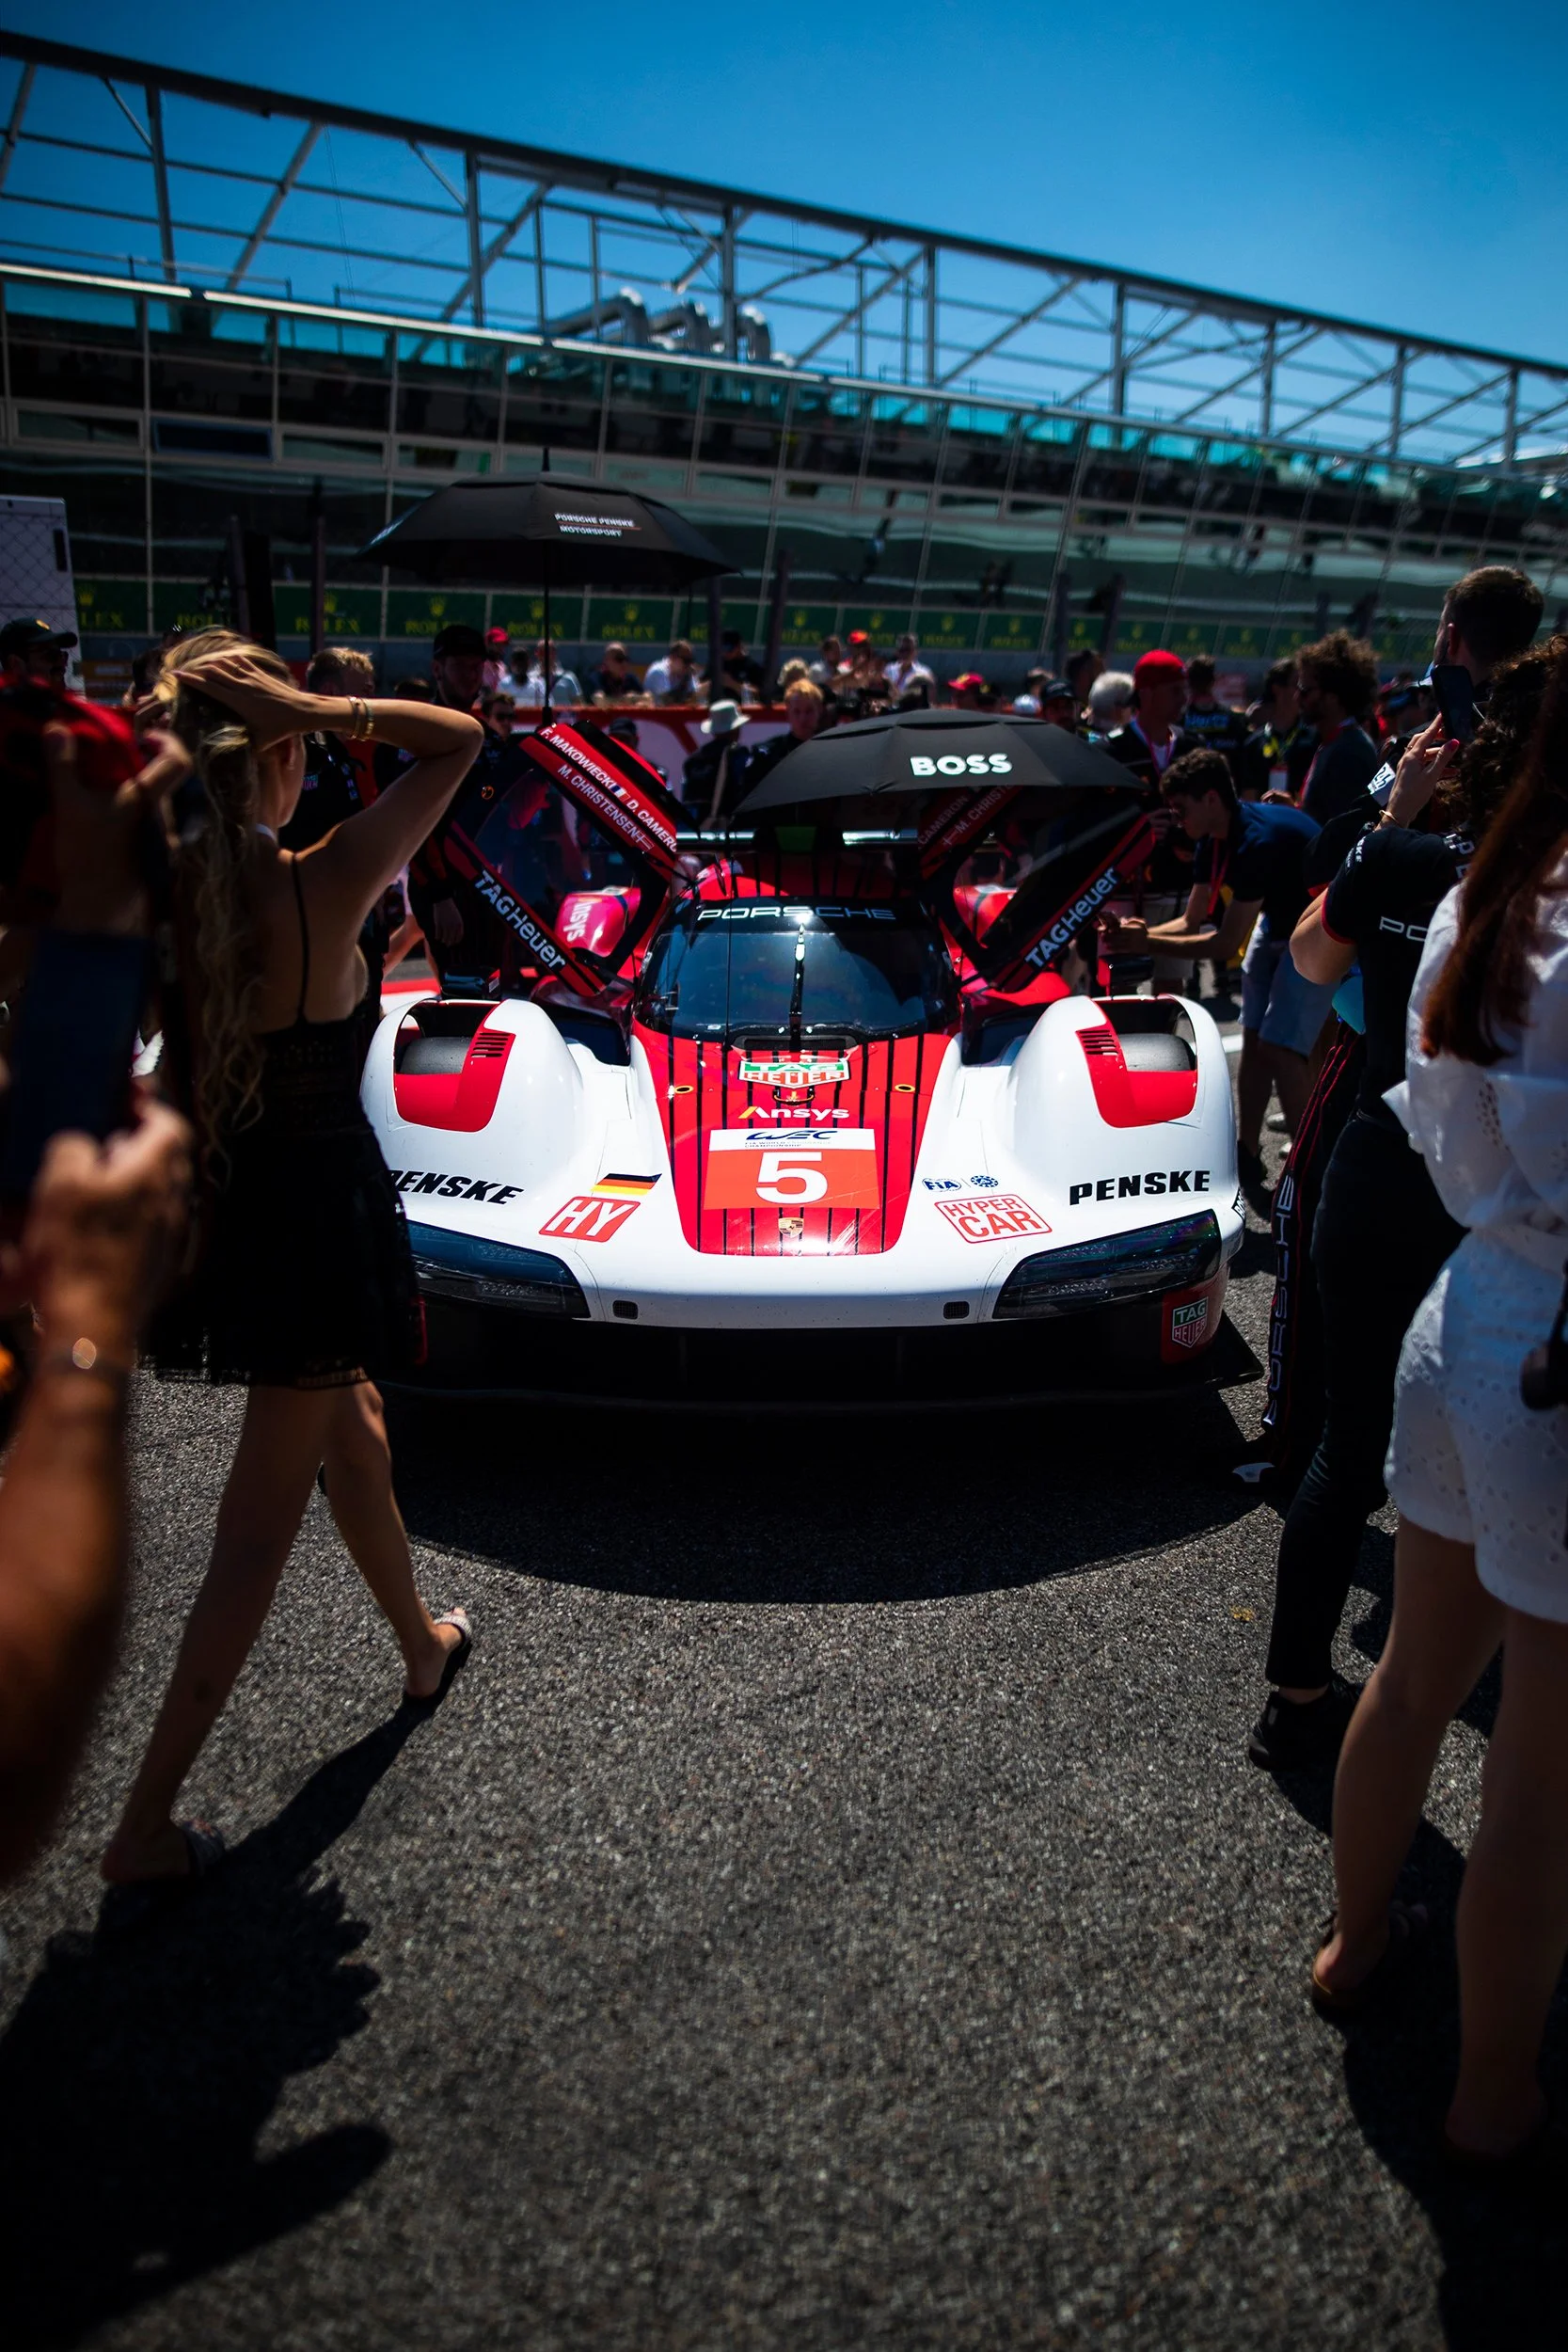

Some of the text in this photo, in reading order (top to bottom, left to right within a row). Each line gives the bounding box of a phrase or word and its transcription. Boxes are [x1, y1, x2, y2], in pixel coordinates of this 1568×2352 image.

[549, 734, 617, 792] MAKOWIECKI
[911, 753, 1013, 776] BOSS
[570, 774, 639, 840] CHRISTENSEN
[697, 906, 896, 921] PORSCHE
[747, 1072, 843, 1085] HEUER
[749, 1062, 839, 1072] TAG
[738, 1106, 850, 1121] Ansys
[746, 1130, 838, 1140] WEC
[755, 1152, 828, 1204] 5
[1069, 1169, 1211, 1206] PENSKE
[546, 1200, 634, 1237] HY
[943, 1198, 1023, 1216] HYPER
[958, 1210, 1042, 1237] CAR
[1176, 1302, 1206, 1324] TAG
[1174, 1318, 1206, 1344] HEUER
